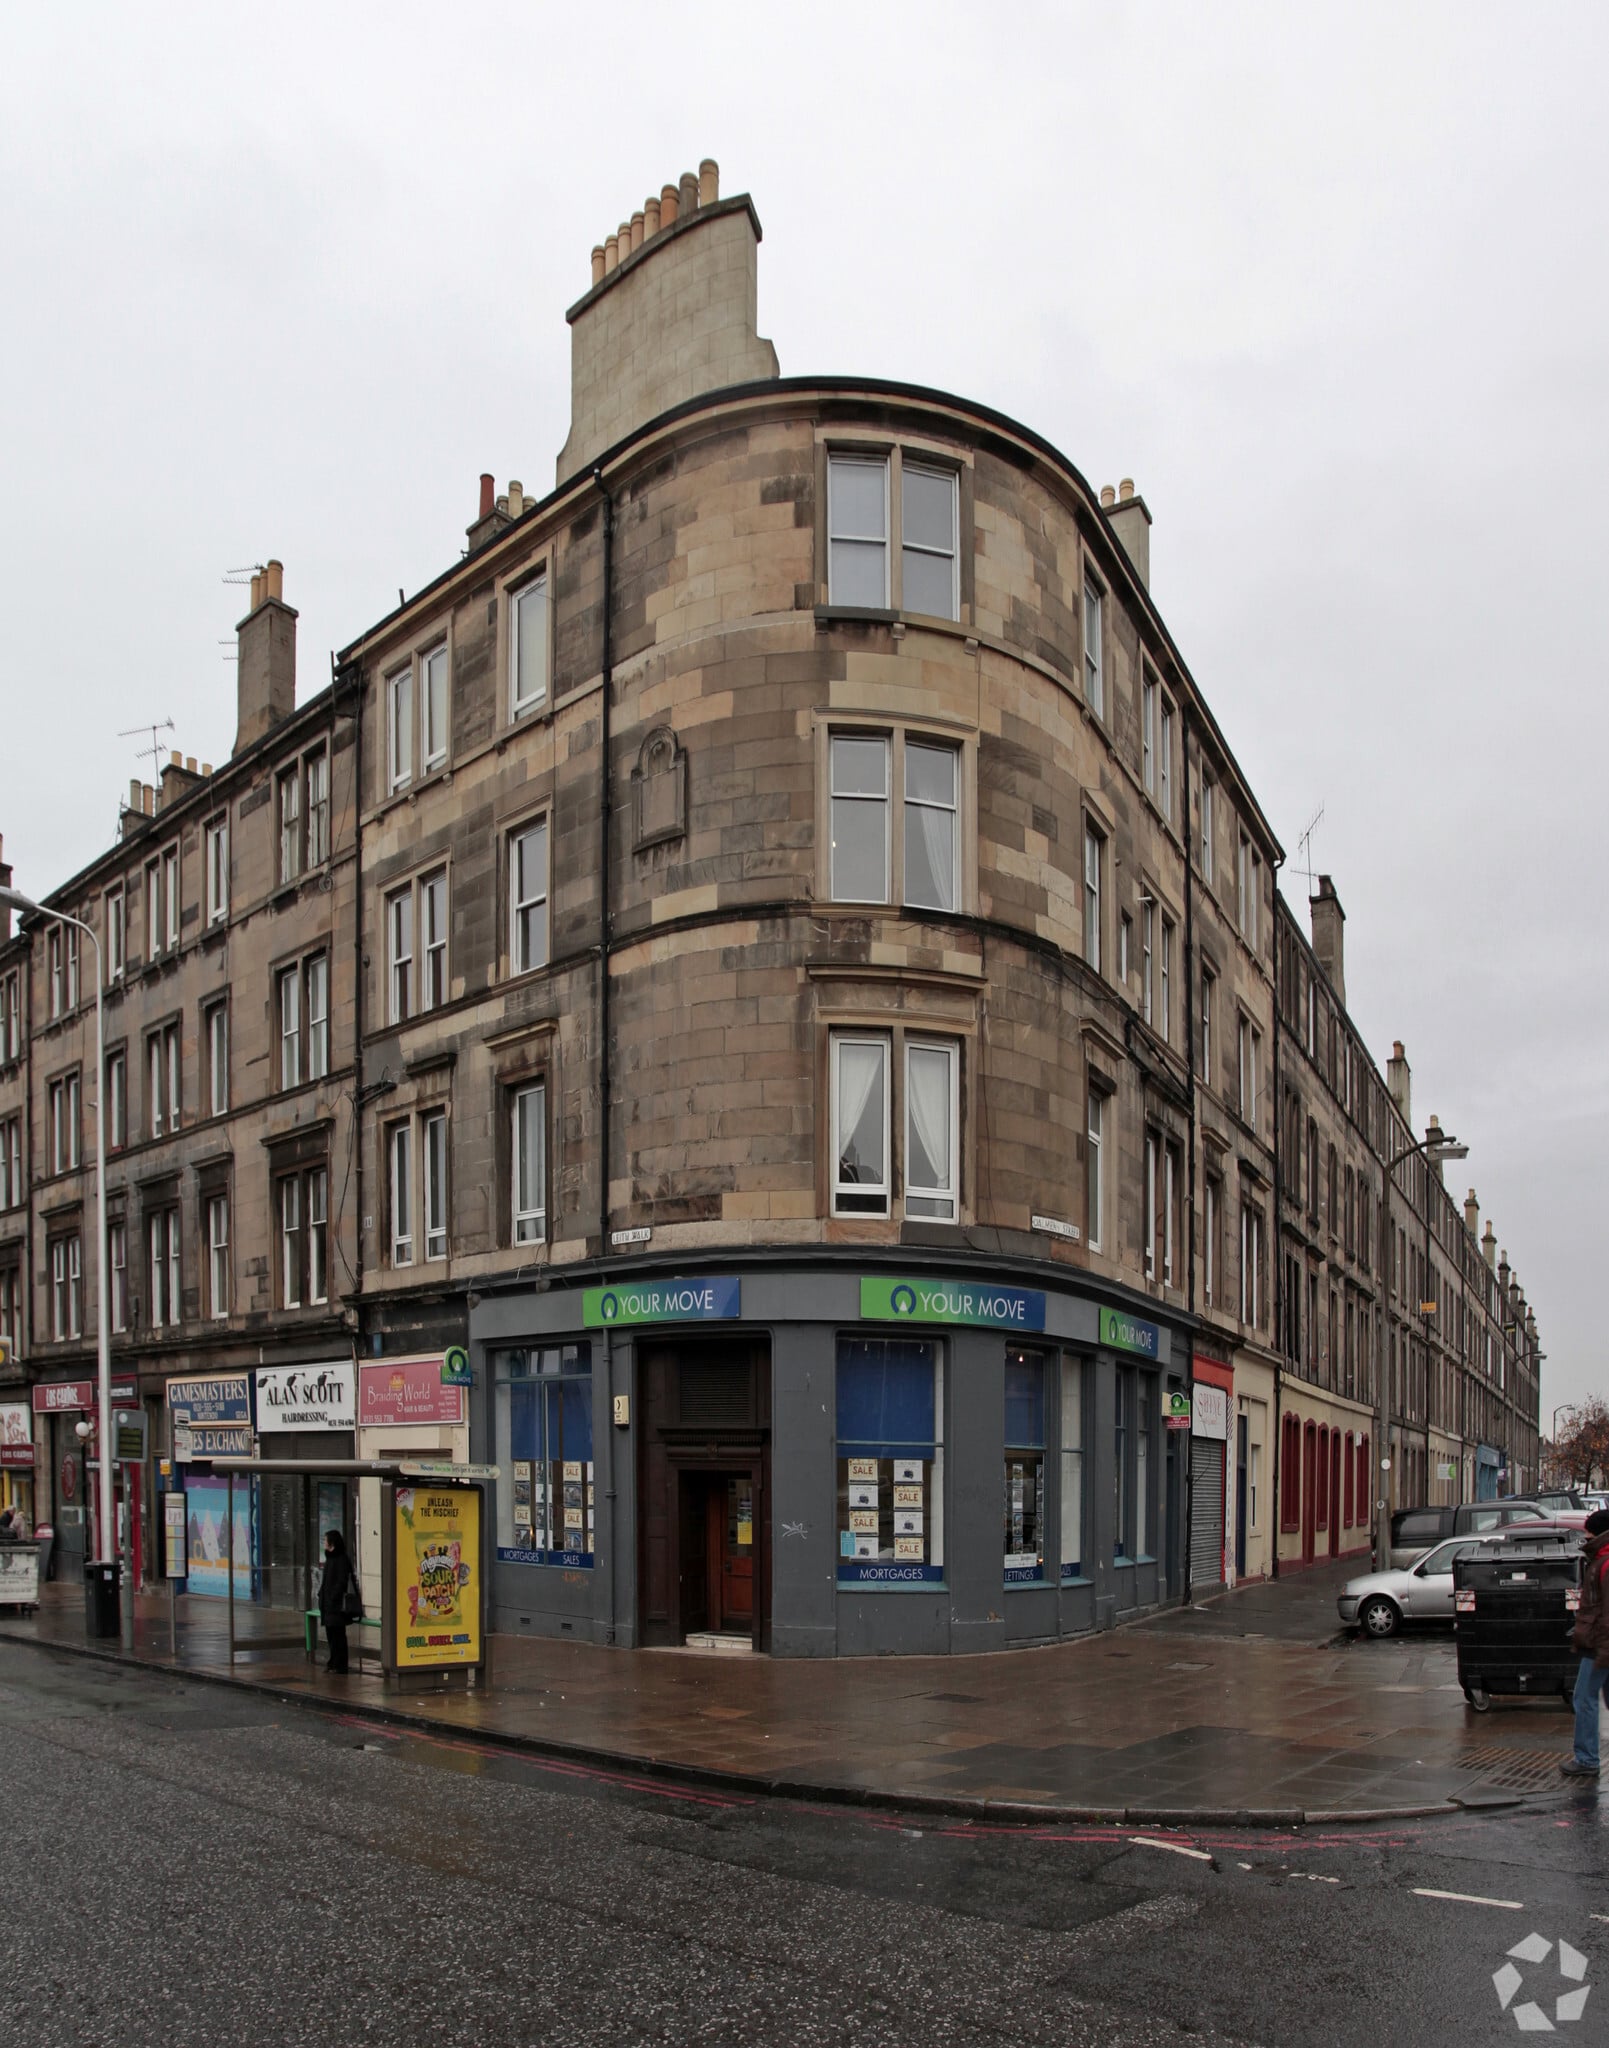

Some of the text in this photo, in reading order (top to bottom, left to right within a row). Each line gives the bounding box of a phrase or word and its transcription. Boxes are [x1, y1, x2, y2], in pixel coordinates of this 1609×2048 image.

[613, 1229, 650, 1243] LEITH WALK
[620, 1289, 713, 1316] YOUR MOVE
[920, 1292, 1025, 1320] YOUR MOVE
[1118, 1323, 1152, 1350] YOUR MOVE
[444, 1375, 471, 1384] YOUR MOVE
[266, 1382, 343, 1406] ALAN SCOTT
[367, 1383, 431, 1413] Braiding World
[418, 1404, 434, 1412] BEAUTY
[281, 1411, 328, 1423] HAIRDRESSING
[206, 1430, 250, 1452] EXCHANG
[853, 1466, 873, 1475] SALE
[427, 1498, 453, 1507] UNLEASH
[898, 1493, 919, 1502] SALE
[421, 1508, 459, 1517] THE MISCHIEF
[516, 1512, 528, 1520] SALE
[567, 1515, 579, 1523] SALE
[854, 1518, 874, 1527] SALE
[899, 1544, 919, 1553] SALE
[503, 1550, 540, 1562] MORTGAGES
[563, 1555, 580, 1566] SALES
[423, 1571, 453, 1586] SOUR
[860, 1568, 923, 1579] MORTGAGES
[1005, 1569, 1034, 1581] LETTINGS
[423, 1583, 455, 1598] PATCH
